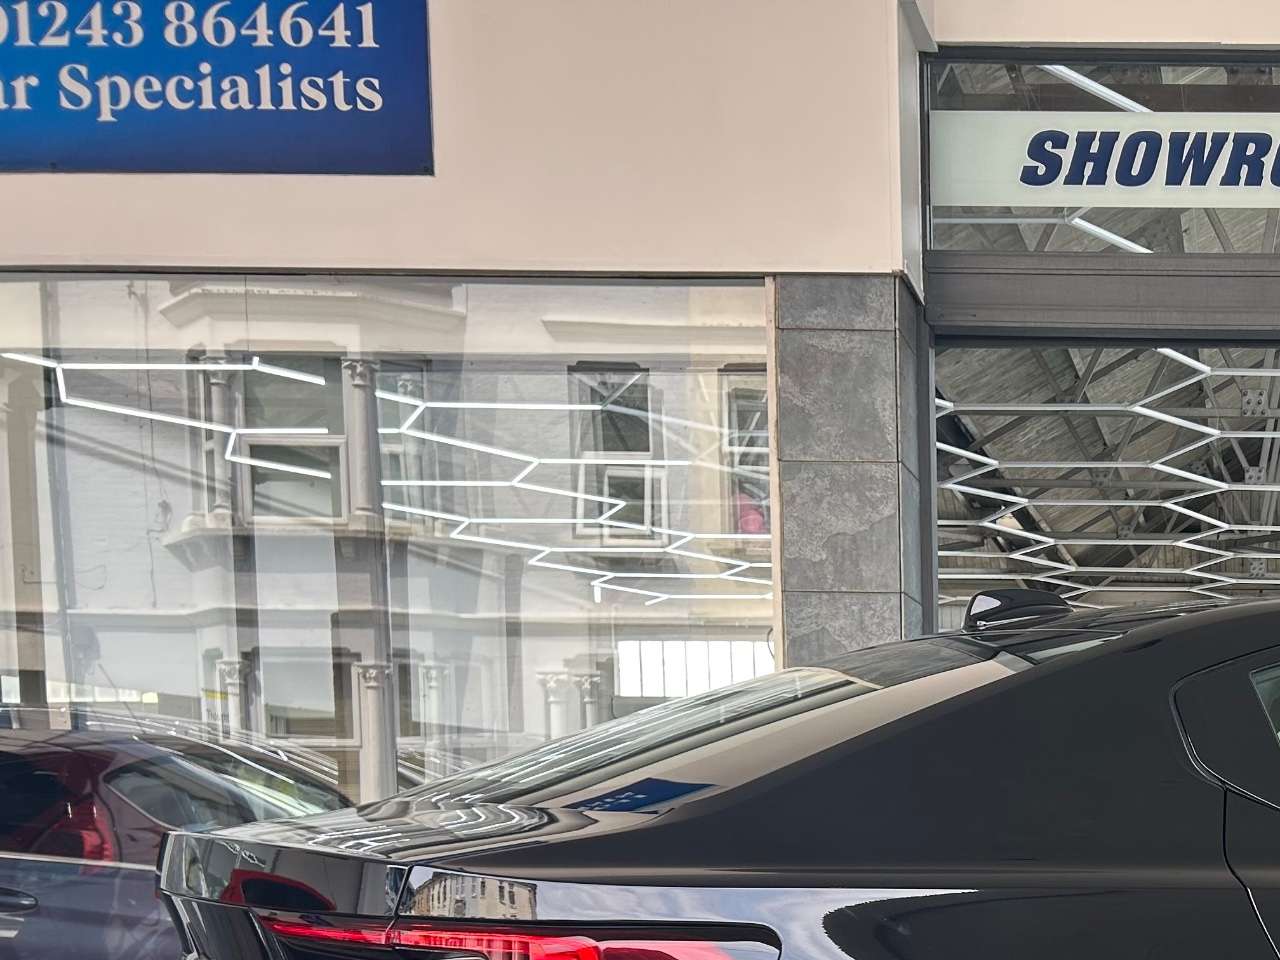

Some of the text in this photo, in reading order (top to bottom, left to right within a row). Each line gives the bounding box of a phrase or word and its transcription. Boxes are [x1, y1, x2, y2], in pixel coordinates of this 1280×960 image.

[164, 0, 380, 48] 864641
[0, 62, 384, 122] r Specialists
